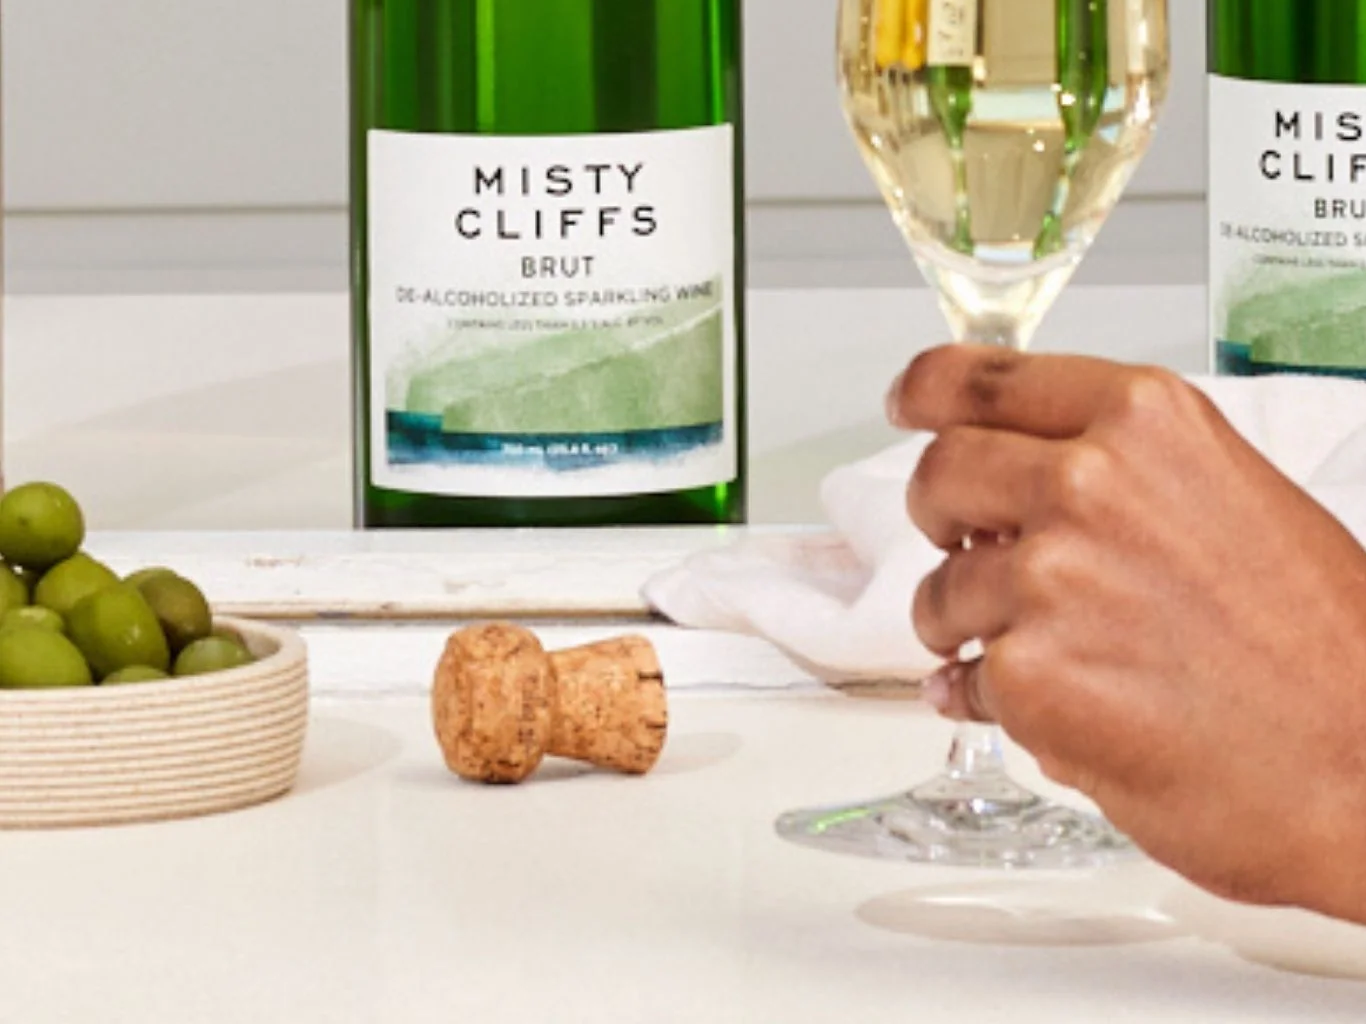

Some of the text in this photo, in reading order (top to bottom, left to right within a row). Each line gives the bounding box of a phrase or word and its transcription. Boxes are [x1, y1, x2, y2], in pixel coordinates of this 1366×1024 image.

[474, 162, 644, 197] MISTY
[455, 205, 658, 240] CLIFFS
[521, 255, 595, 278] BRUT
[396, 280, 713, 308] DE-ALCOHOLIZED SPARKLING WINE
